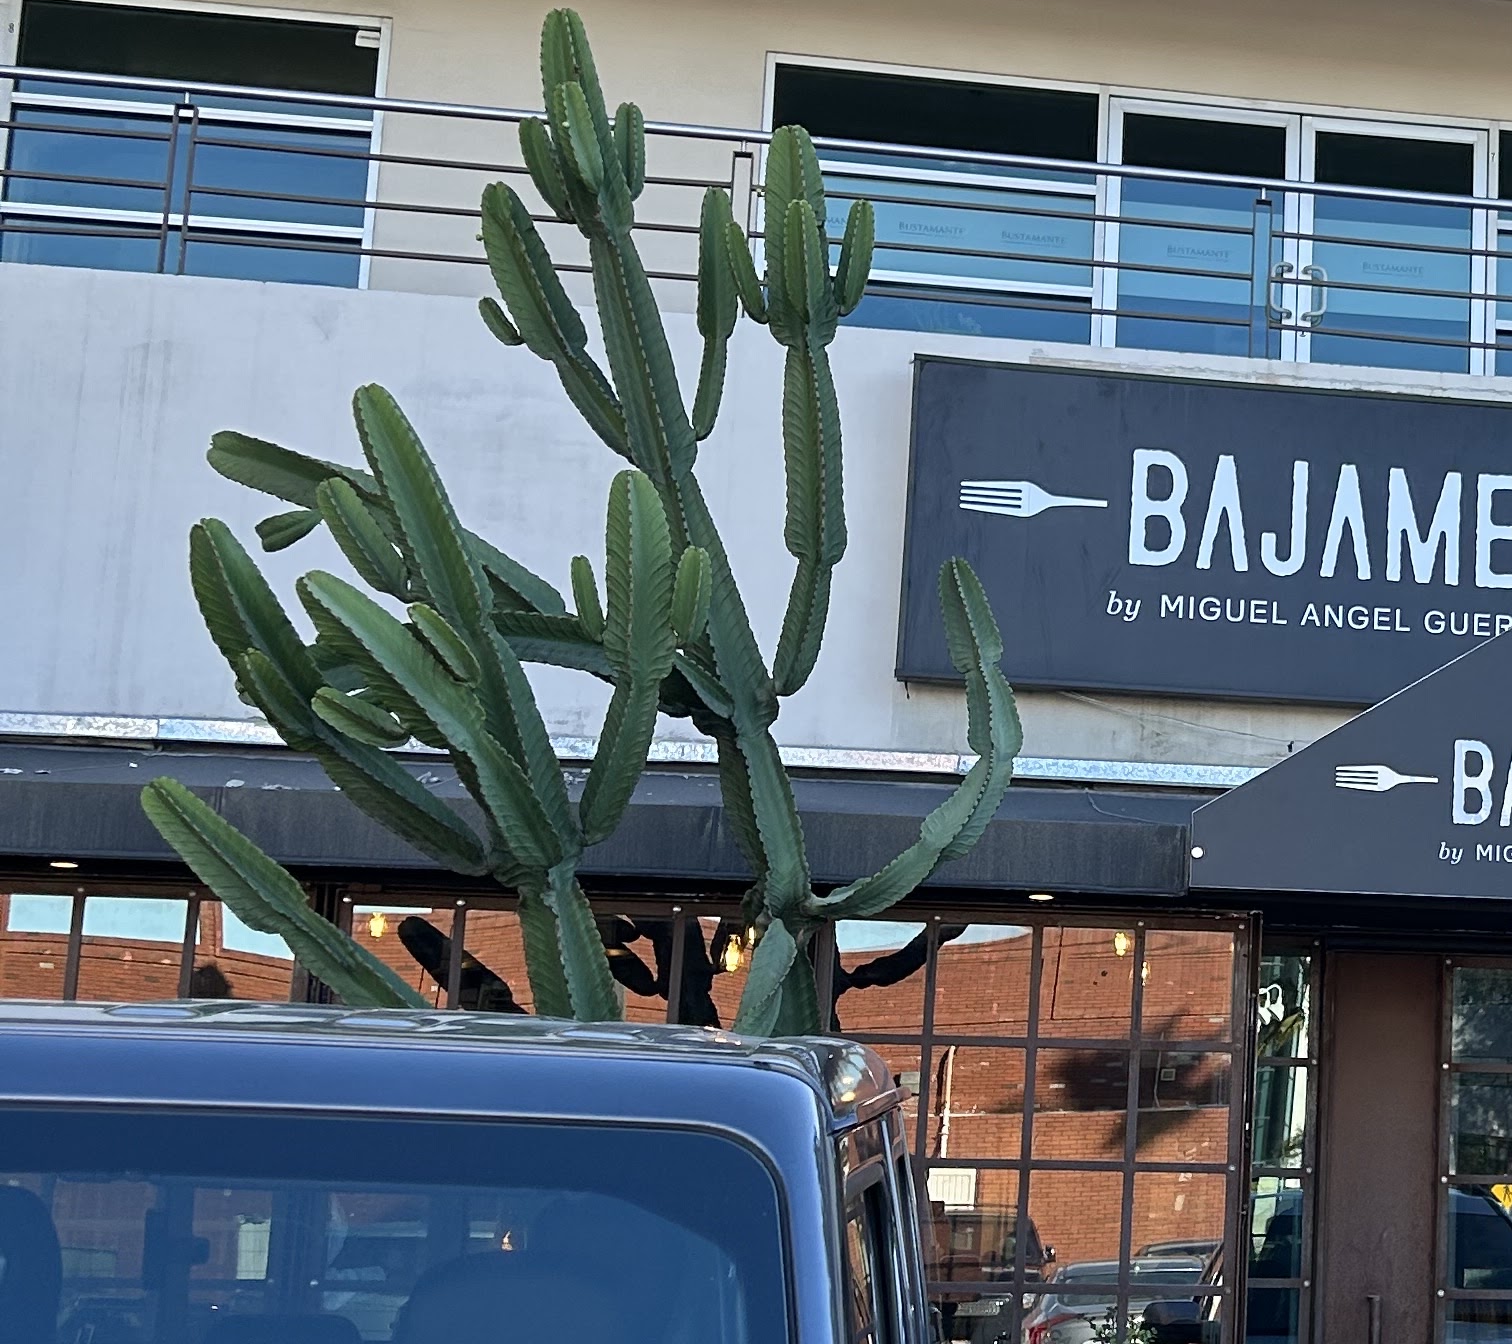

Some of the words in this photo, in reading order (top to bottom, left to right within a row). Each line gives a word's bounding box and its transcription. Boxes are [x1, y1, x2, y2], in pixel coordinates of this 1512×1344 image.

[1106, 590, 1141, 622] by
[1160, 594, 1288, 625] MIGUEL
[1300, 602, 1411, 632] ANGEL
[1438, 841, 1464, 865] by
